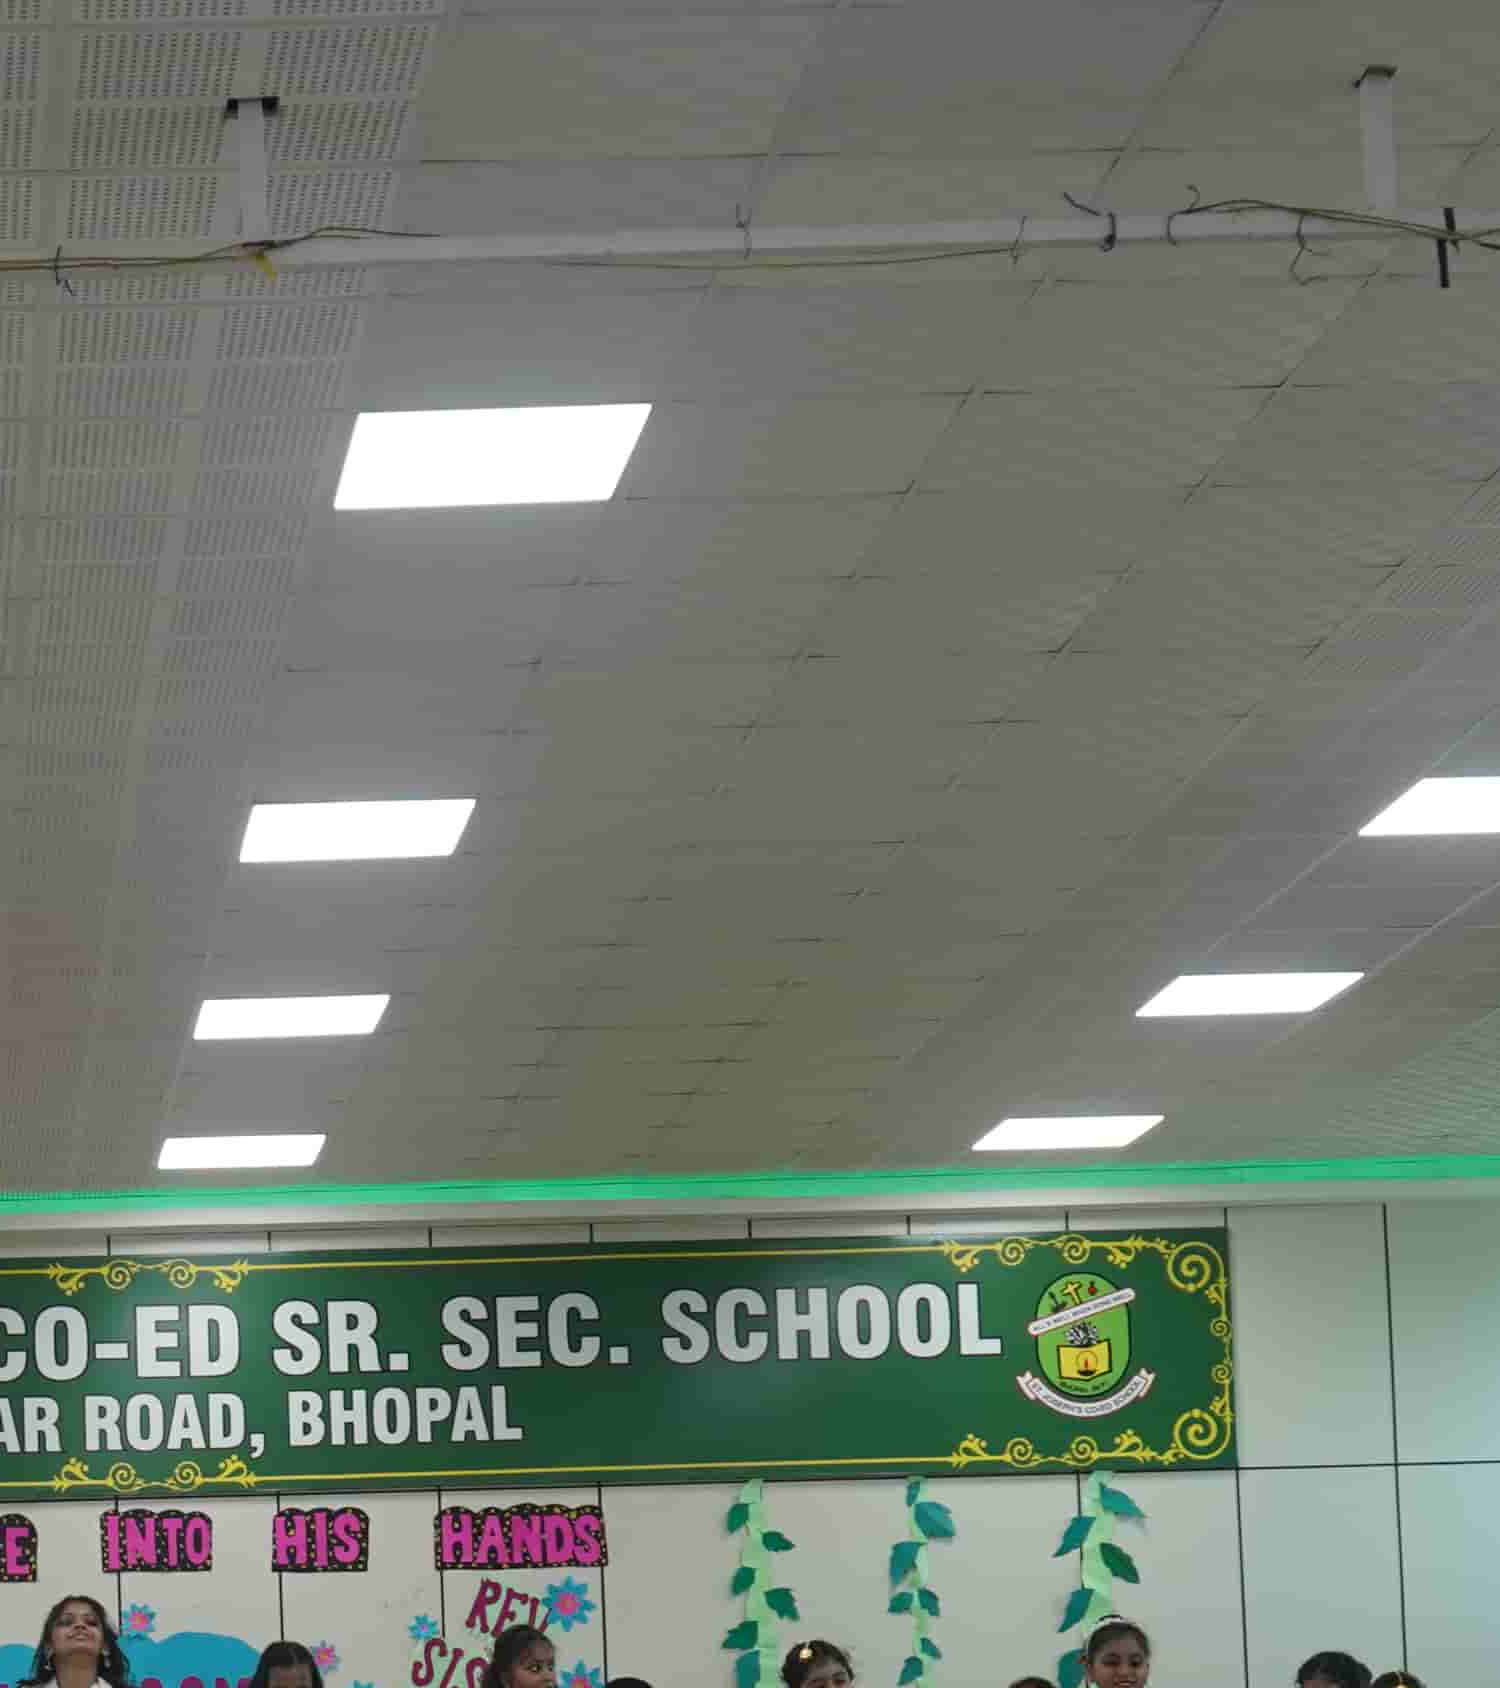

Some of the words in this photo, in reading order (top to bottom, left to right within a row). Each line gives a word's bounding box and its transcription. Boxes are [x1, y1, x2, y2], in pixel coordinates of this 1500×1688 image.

[271, 1300, 409, 1375] SR.
[440, 1292, 629, 1370] SEC.
[660, 1283, 1001, 1363] SCHOOL
[84, 1392, 265, 1459] ROAD,
[287, 1385, 523, 1447] BHOPAL
[106, 1514, 211, 1570] INTO
[272, 1511, 362, 1567] HIS
[439, 1512, 602, 1564] HANDS
